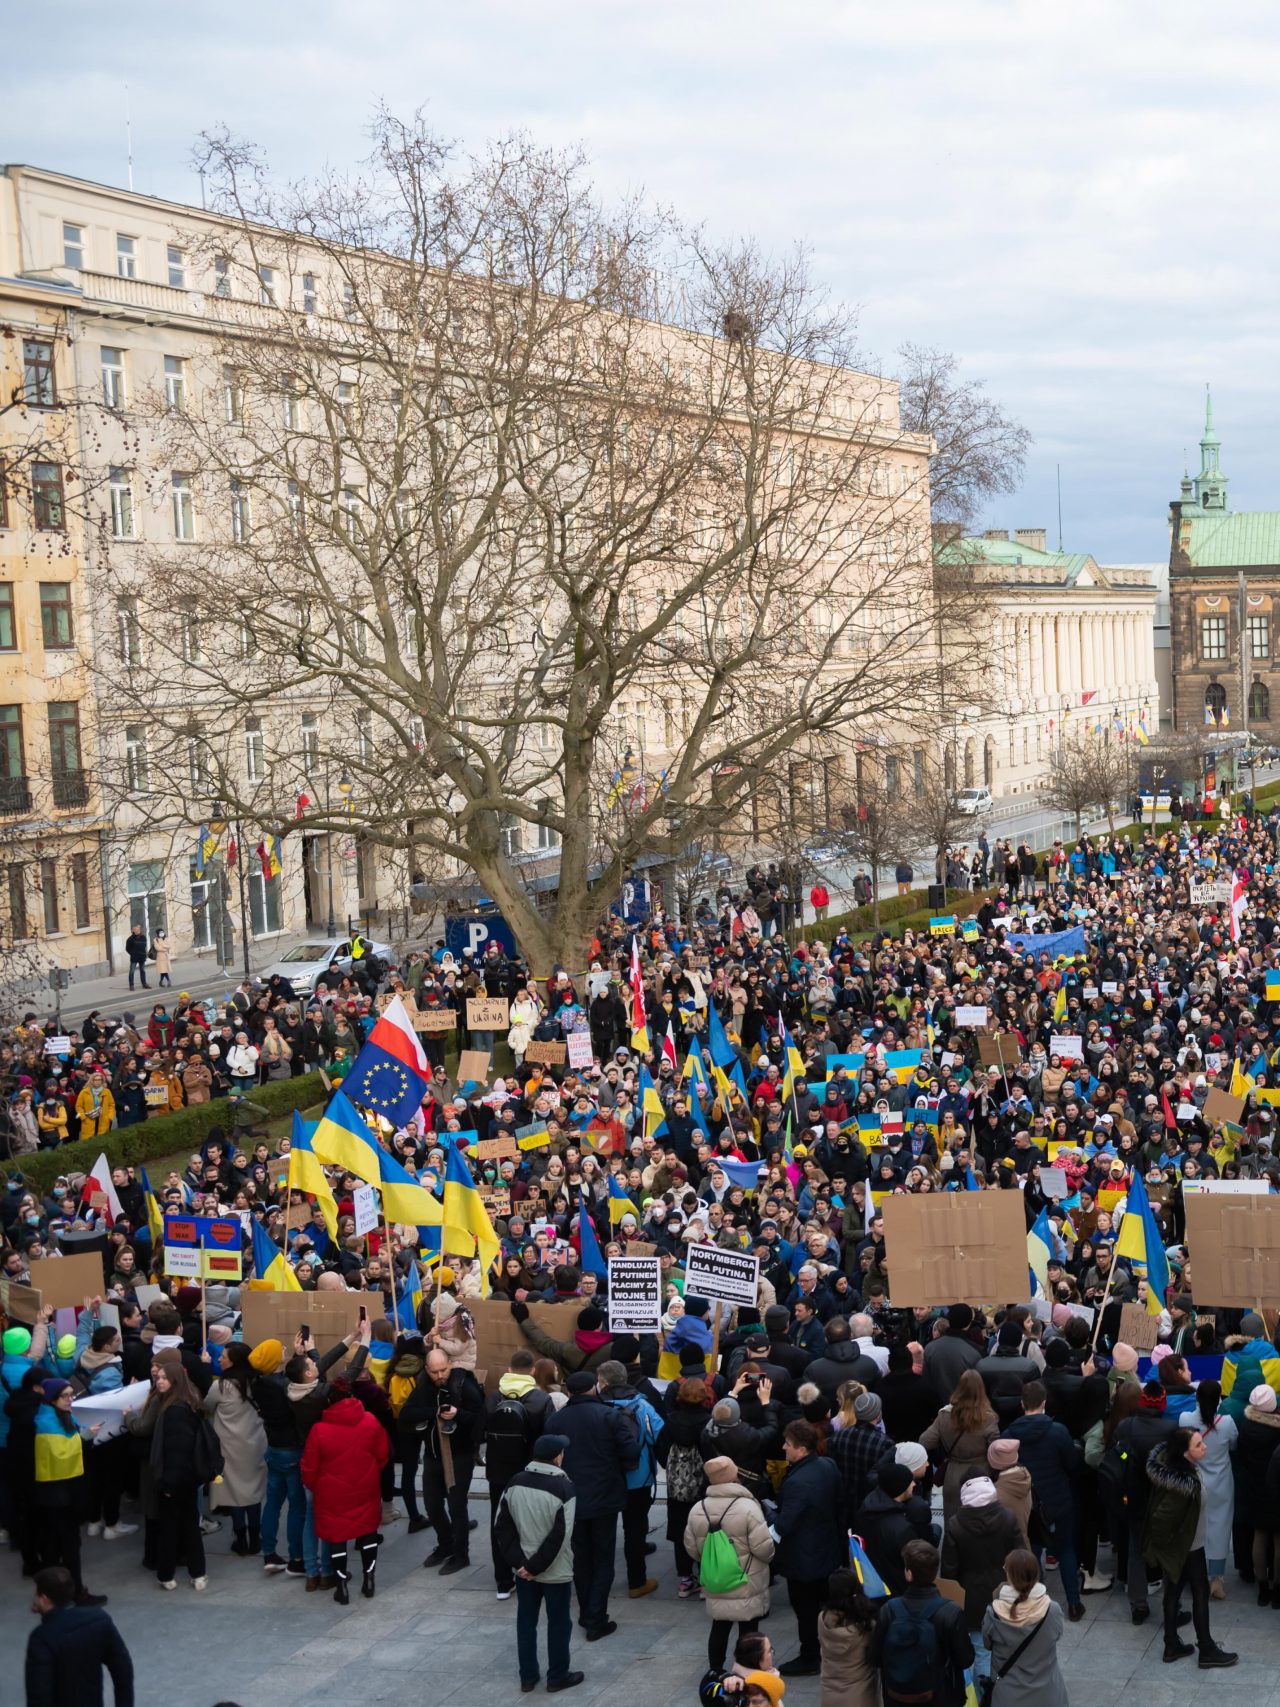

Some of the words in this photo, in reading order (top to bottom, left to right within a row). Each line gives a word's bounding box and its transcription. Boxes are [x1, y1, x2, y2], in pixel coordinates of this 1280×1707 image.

[469, 922, 488, 952] P
[611, 1262, 658, 1271] HANDLUJĄC
[691, 1249, 756, 1270] NORYMBERGA
[691, 1261, 711, 1272] DLA
[712, 1265, 748, 1280] PUTINA
[748, 1273, 753, 1281] !
[614, 1292, 646, 1301] WOJNĘ
[648, 1292, 656, 1300] !!!
